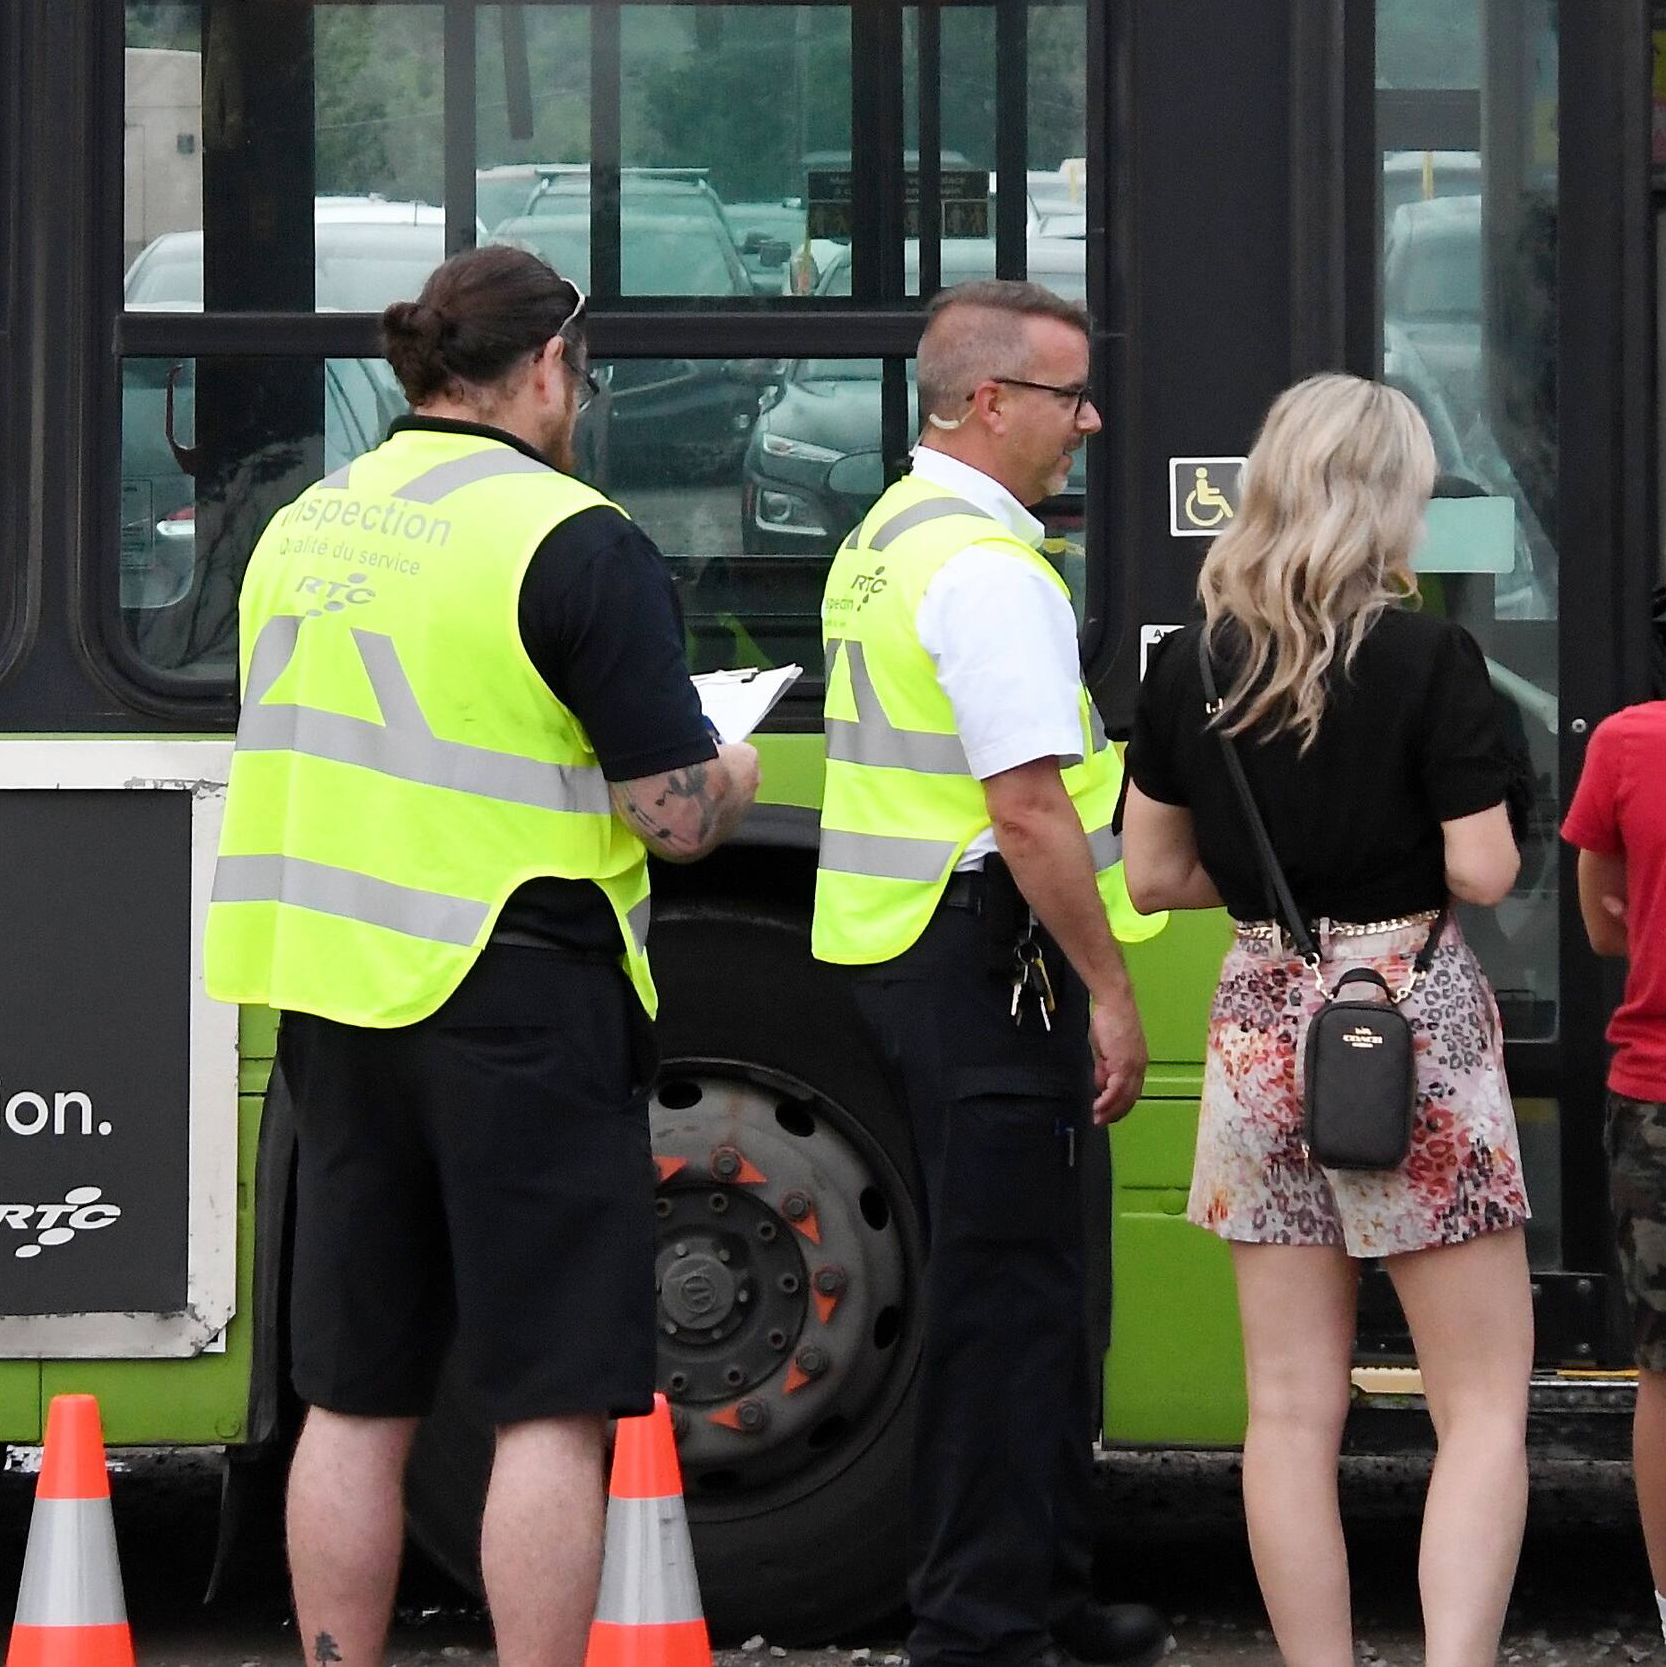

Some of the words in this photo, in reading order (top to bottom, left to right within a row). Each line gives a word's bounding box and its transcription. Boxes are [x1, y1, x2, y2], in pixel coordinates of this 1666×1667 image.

[333, 541, 354, 562] du
[358, 549, 421, 576] service
[295, 576, 376, 605] RTC
[850, 574, 888, 594] RTC
